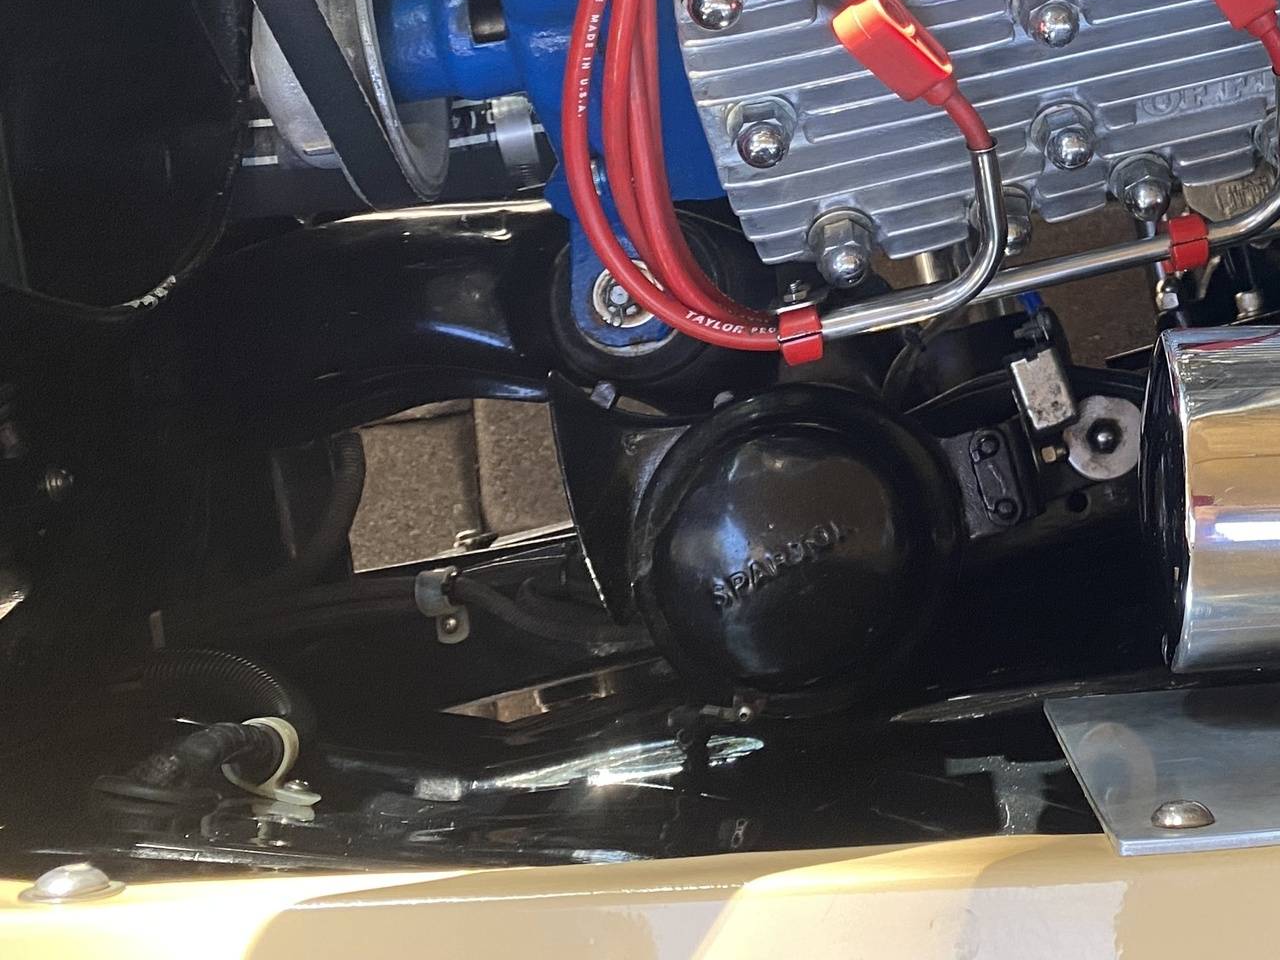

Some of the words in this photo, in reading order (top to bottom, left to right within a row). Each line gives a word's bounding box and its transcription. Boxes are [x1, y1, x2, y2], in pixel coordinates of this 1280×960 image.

[584, 13, 600, 48] MADE
[580, 55, 592, 69] IN
[576, 77, 588, 117] U.S.A.
[684, 310, 746, 334] TAYLOR
[751, 325, 777, 335] PRO
